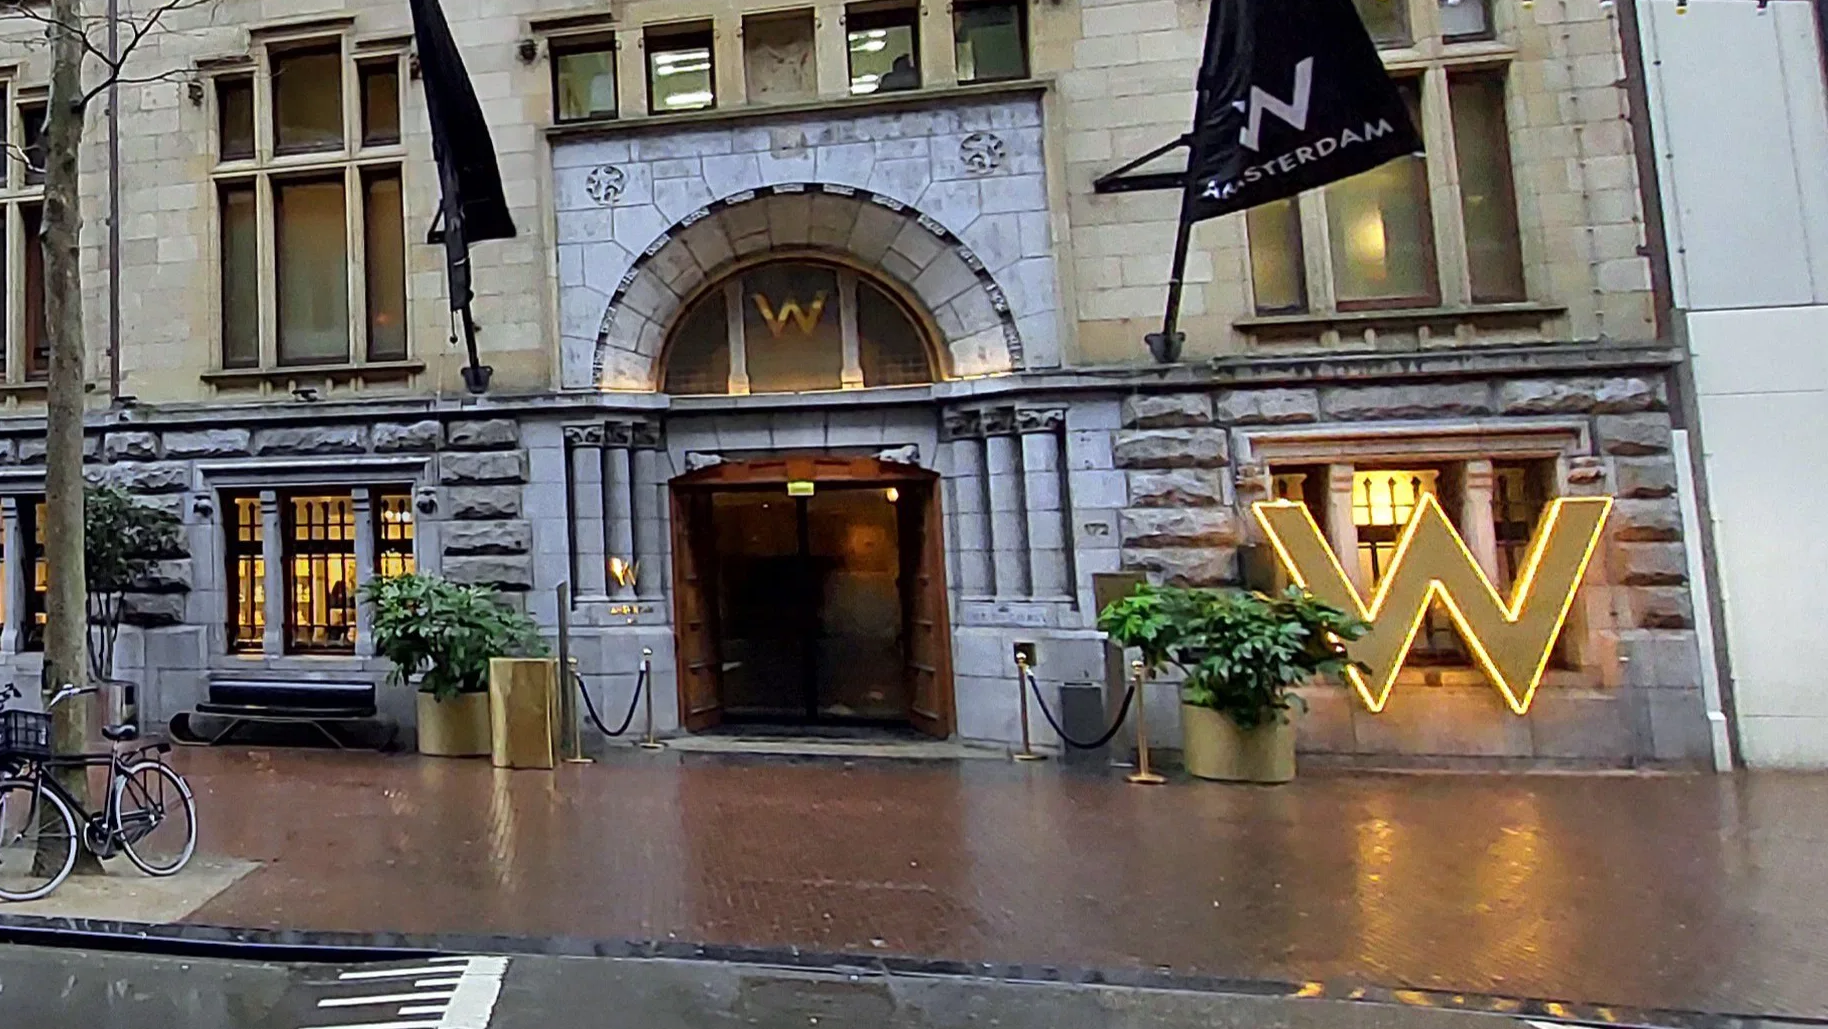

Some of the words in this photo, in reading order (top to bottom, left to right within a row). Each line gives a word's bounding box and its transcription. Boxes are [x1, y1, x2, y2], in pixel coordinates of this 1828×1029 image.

[1201, 118, 1394, 200] AMSTERDAM
[751, 290, 828, 337] W
[1252, 491, 1614, 715] W
